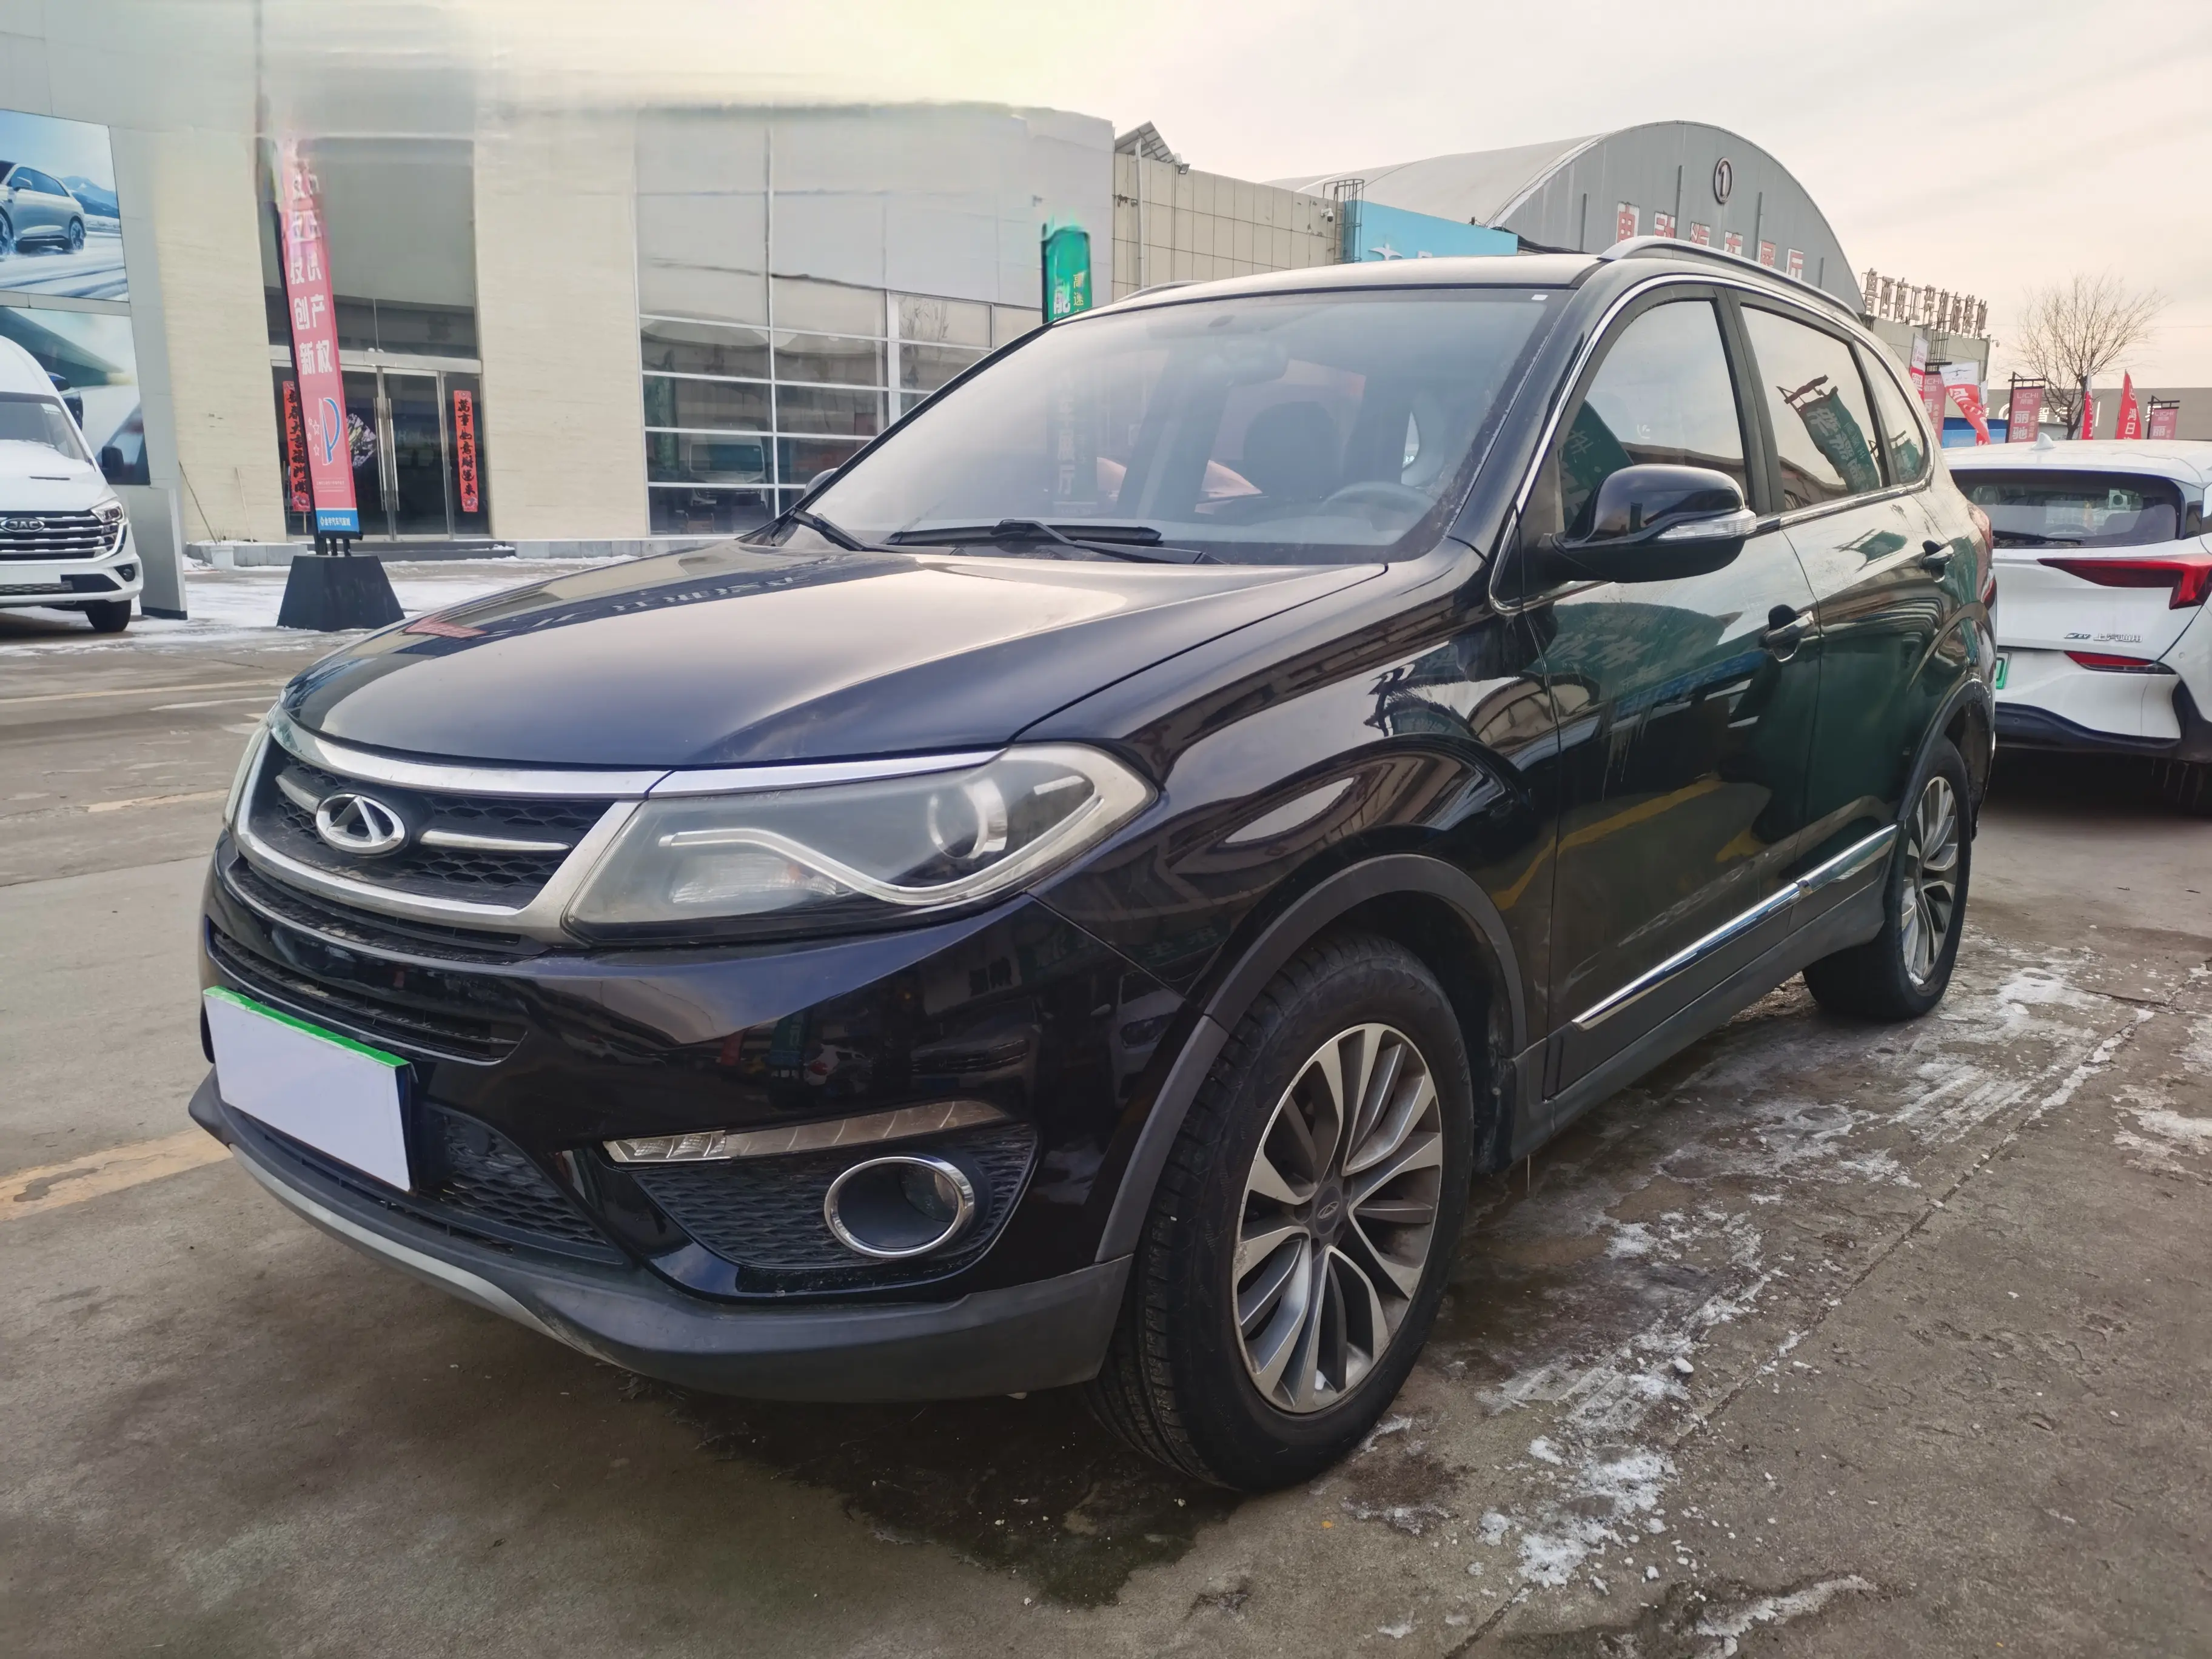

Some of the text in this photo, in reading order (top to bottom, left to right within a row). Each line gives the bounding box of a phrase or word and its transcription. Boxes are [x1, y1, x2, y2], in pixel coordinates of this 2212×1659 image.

[2013, 411, 2030, 440] 丽驰
[2122, 407, 2137, 440] 鸿日
[2093, 632, 2143, 643] 上汽通用
